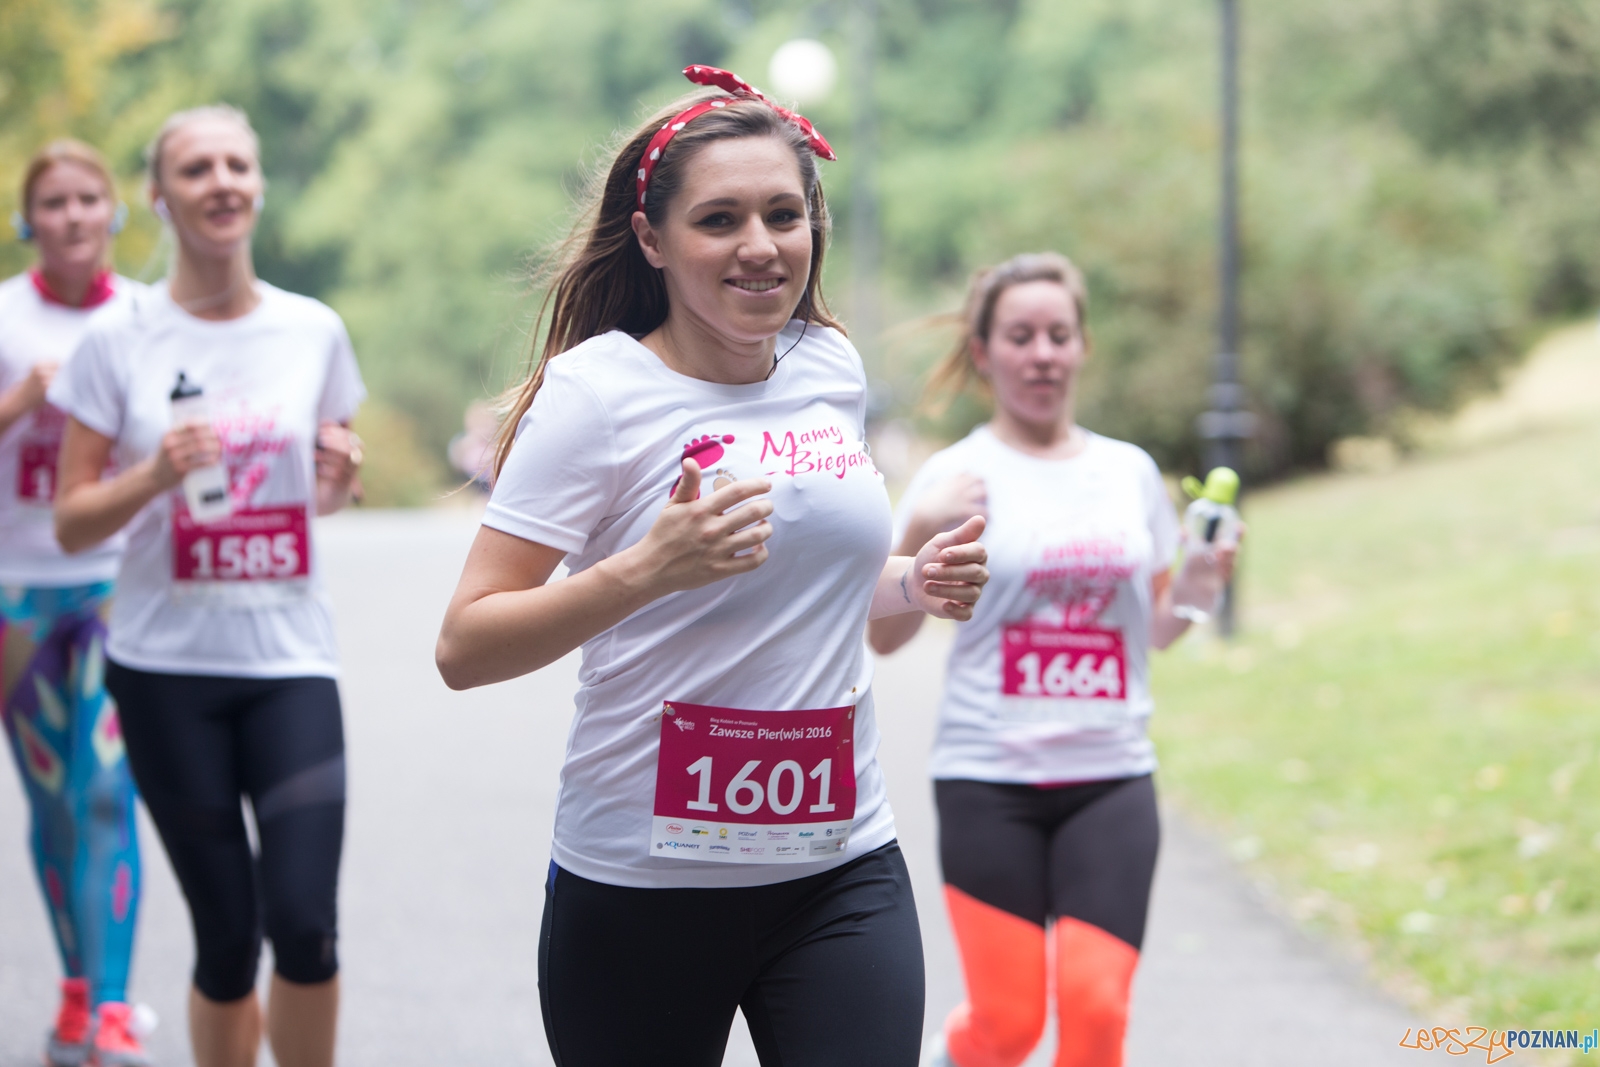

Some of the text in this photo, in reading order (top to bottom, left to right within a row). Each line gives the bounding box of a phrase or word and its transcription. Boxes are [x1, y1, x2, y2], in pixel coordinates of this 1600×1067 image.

[760, 426, 843, 464] Mamy
[191, 532, 300, 578] 1585
[1016, 652, 1123, 697] 1664
[709, 724, 832, 742] Zawsze Pier(w)si 2016
[686, 756, 836, 815] 1601
